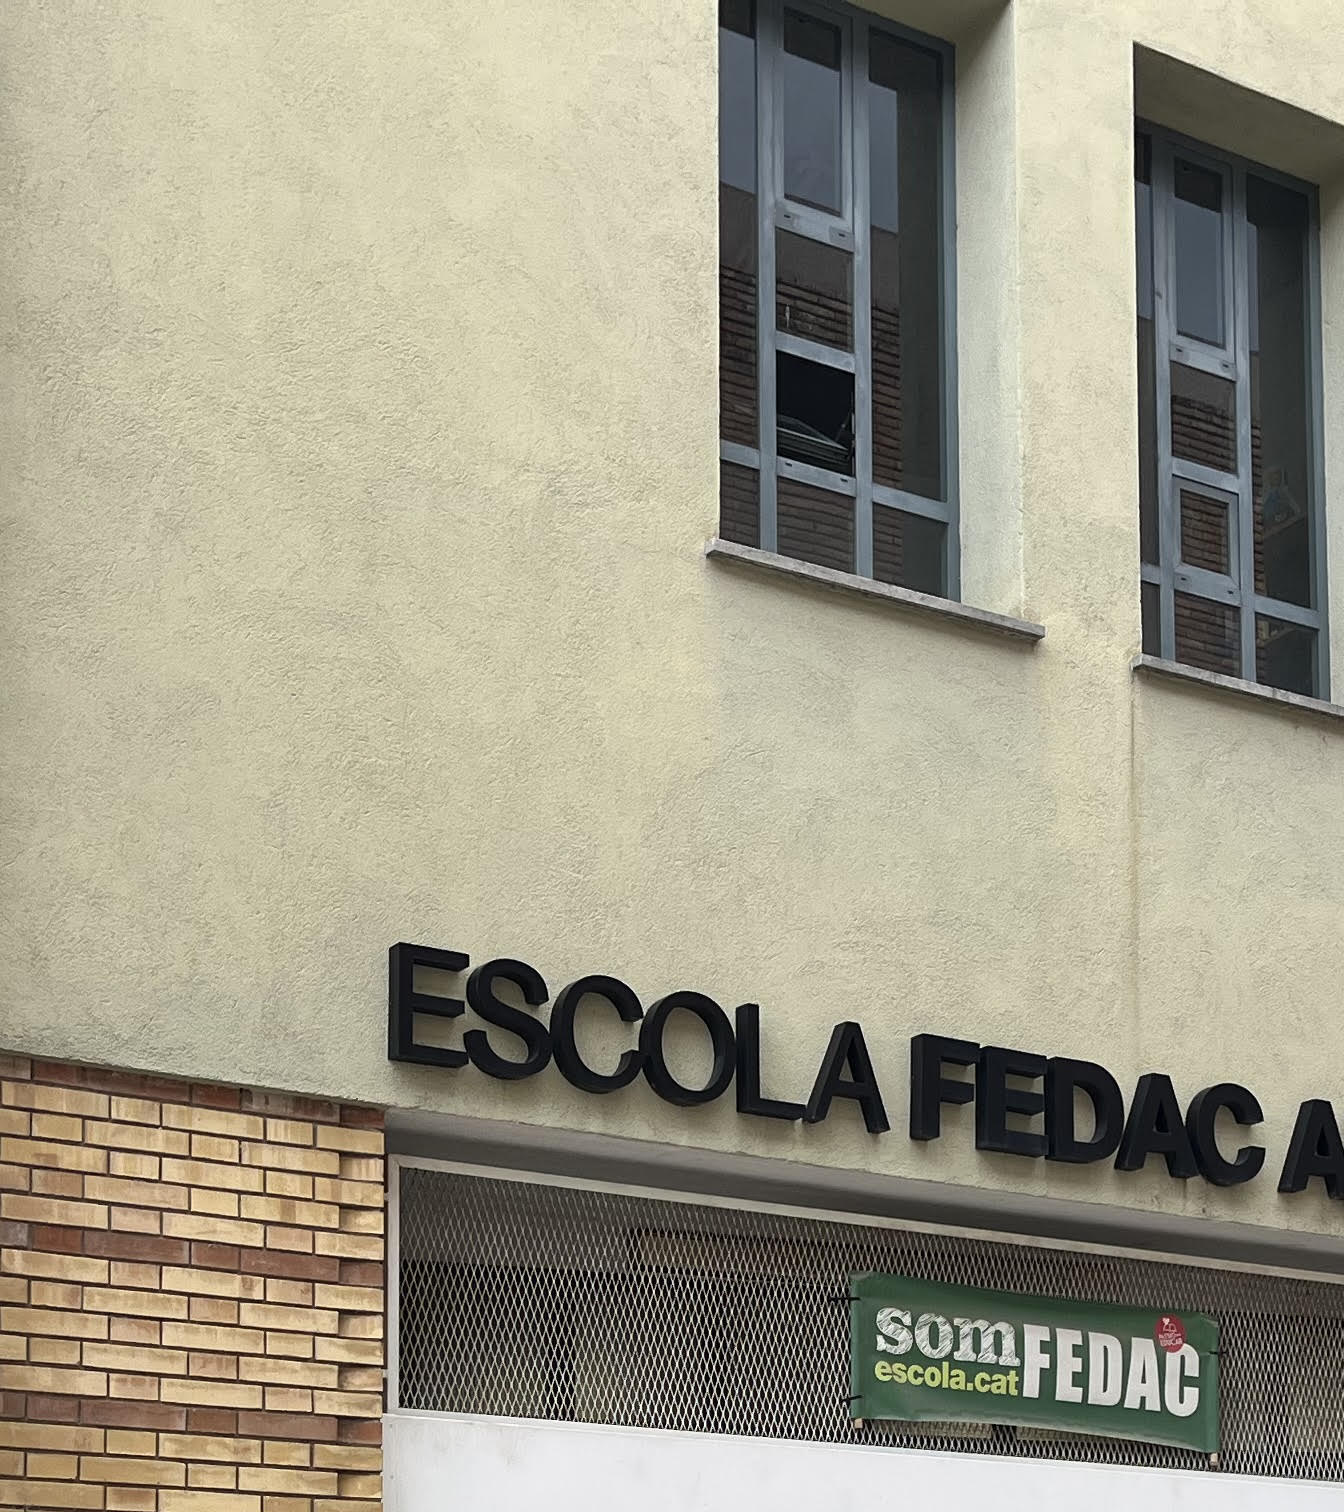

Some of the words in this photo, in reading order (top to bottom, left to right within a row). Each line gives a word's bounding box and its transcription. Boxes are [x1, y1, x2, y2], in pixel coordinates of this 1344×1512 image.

[388, 941, 891, 1134] ESCOLA
[909, 1033, 1265, 1187] FEDAC
[874, 1359, 1020, 1397] escola.cat
[875, 1307, 1021, 1367] som
[1022, 1322, 1200, 1418] FEDAC
